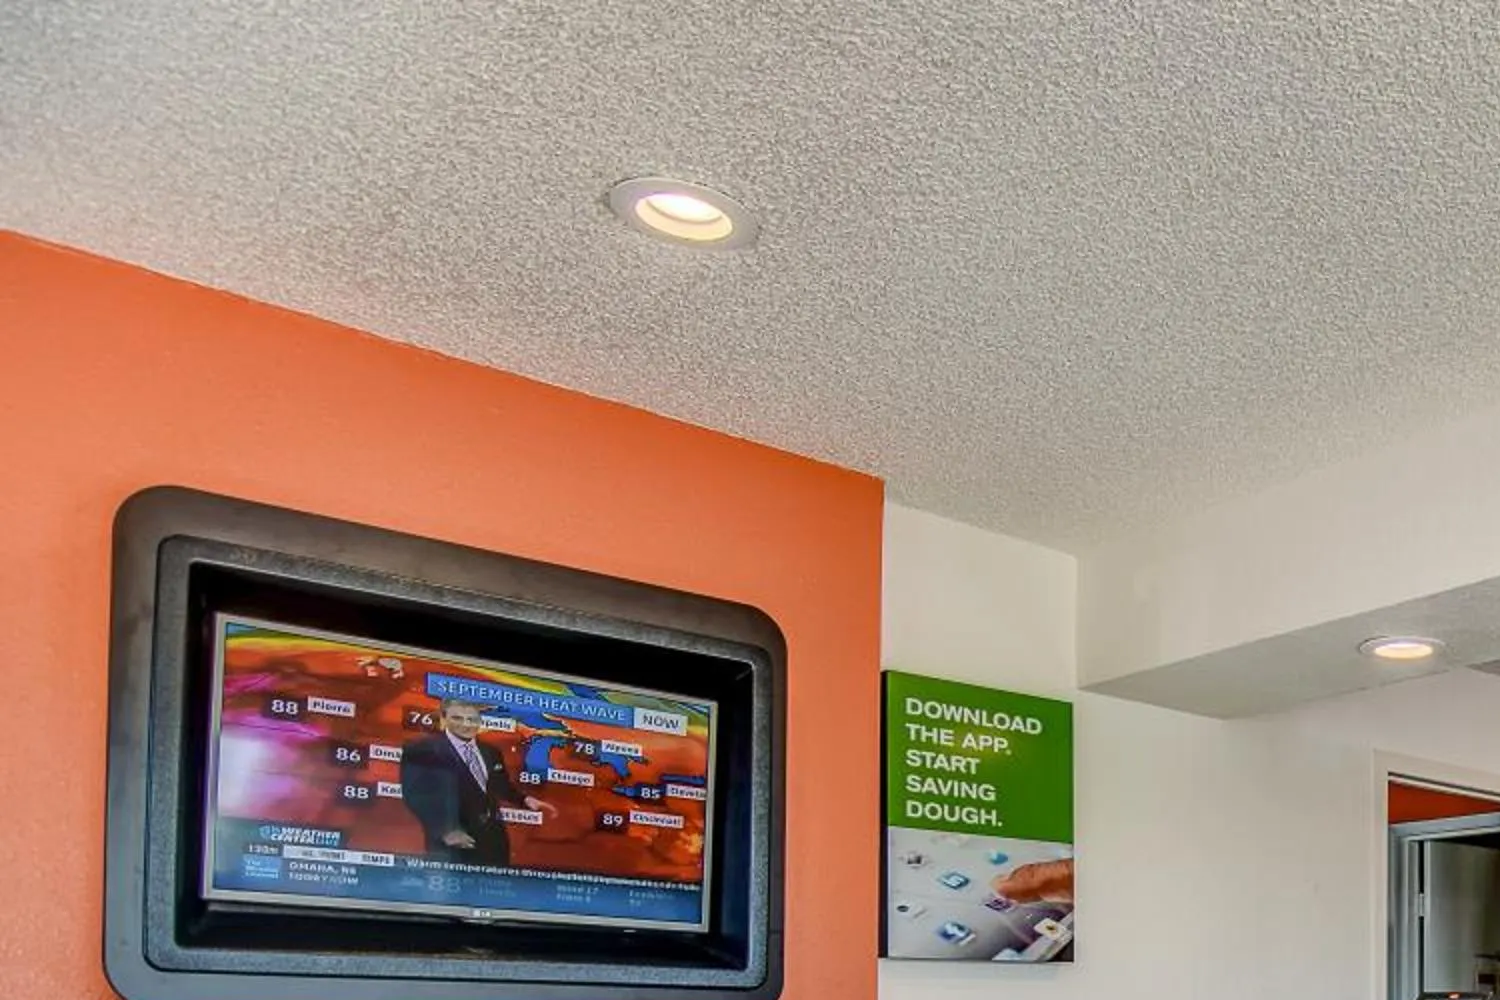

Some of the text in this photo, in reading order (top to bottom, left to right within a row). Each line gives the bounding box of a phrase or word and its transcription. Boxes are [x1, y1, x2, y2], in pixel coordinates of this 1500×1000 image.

[271, 699, 298, 715] 88
[437, 680, 626, 721] SEPTEMBER HEAT WAVE
[409, 711, 433, 726] 76
[642, 714, 680, 729] NOW
[905, 697, 1042, 736] DOWNLOAD
[905, 722, 1012, 755] THE APP.
[336, 747, 361, 762] 86
[574, 741, 595, 755] 78
[905, 749, 981, 775] START
[520, 771, 591, 785] 88 Chicago
[344, 785, 369, 799] 88
[641, 787, 661, 799] 85
[905, 774, 996, 801] SAVING
[603, 813, 623, 827] 89
[905, 800, 1003, 827] DOUGH.
[407, 857, 441, 869] Warm
